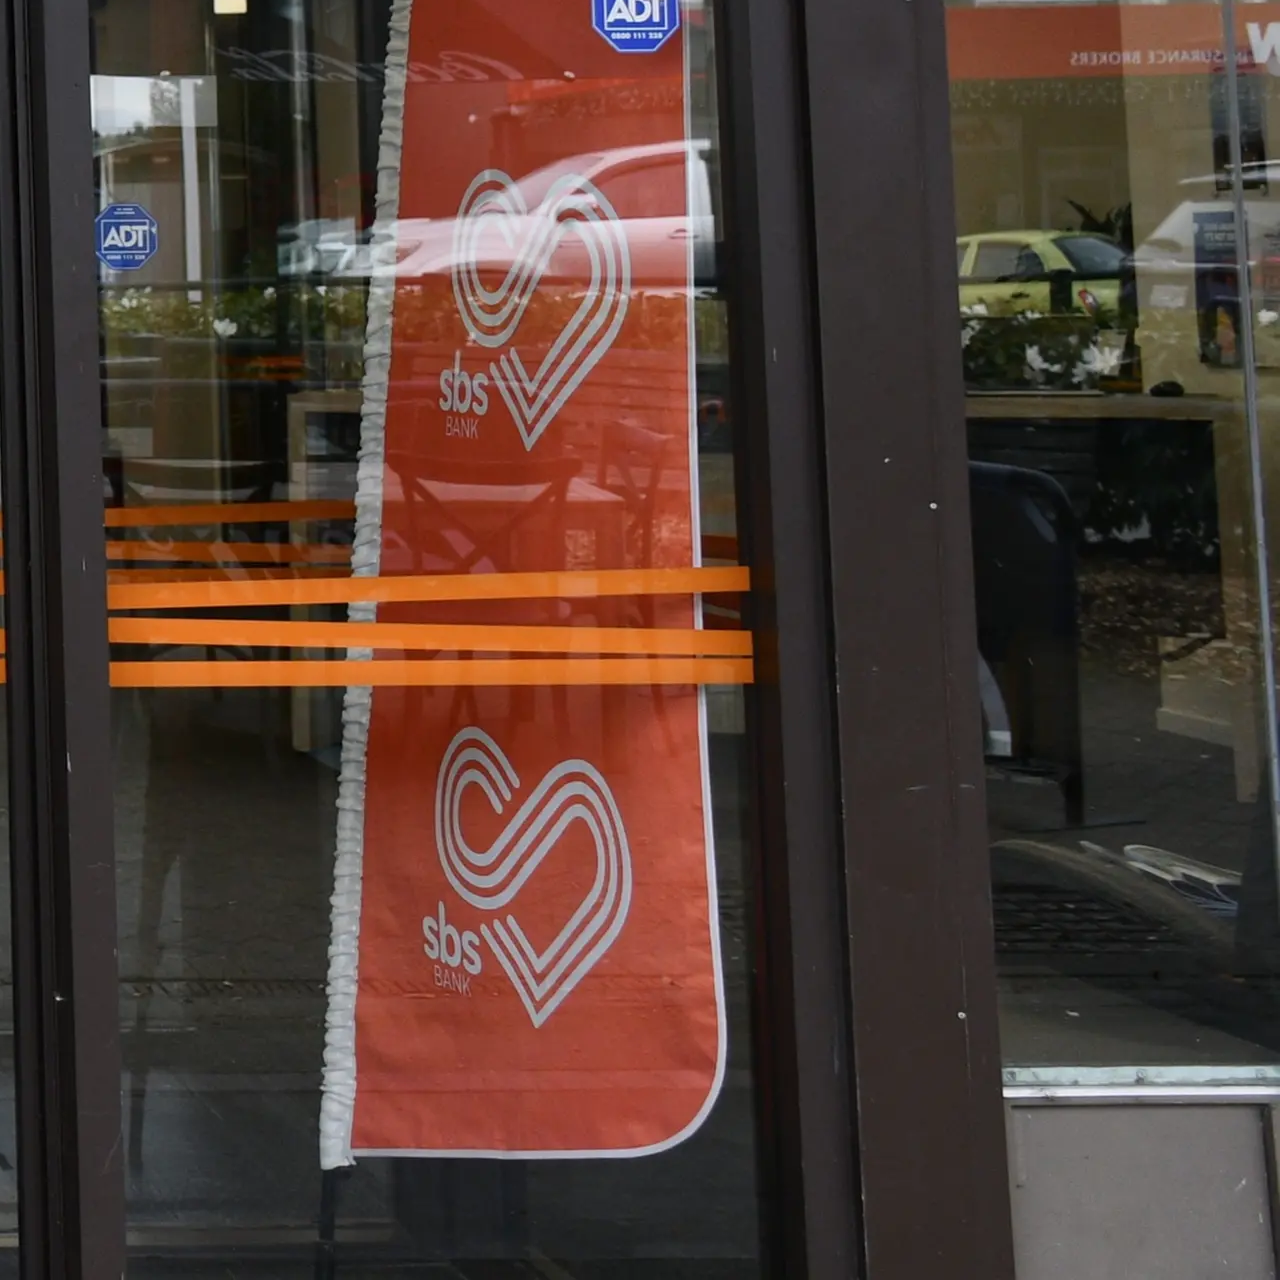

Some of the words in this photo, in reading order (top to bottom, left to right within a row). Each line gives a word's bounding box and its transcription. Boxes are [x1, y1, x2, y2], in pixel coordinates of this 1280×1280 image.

[102, 225, 149, 247] ADT
[439, 349, 489, 416] sbs
[446, 415, 479, 439] BANK
[423, 900, 482, 975] sbs
[434, 964, 472, 997] BANK
